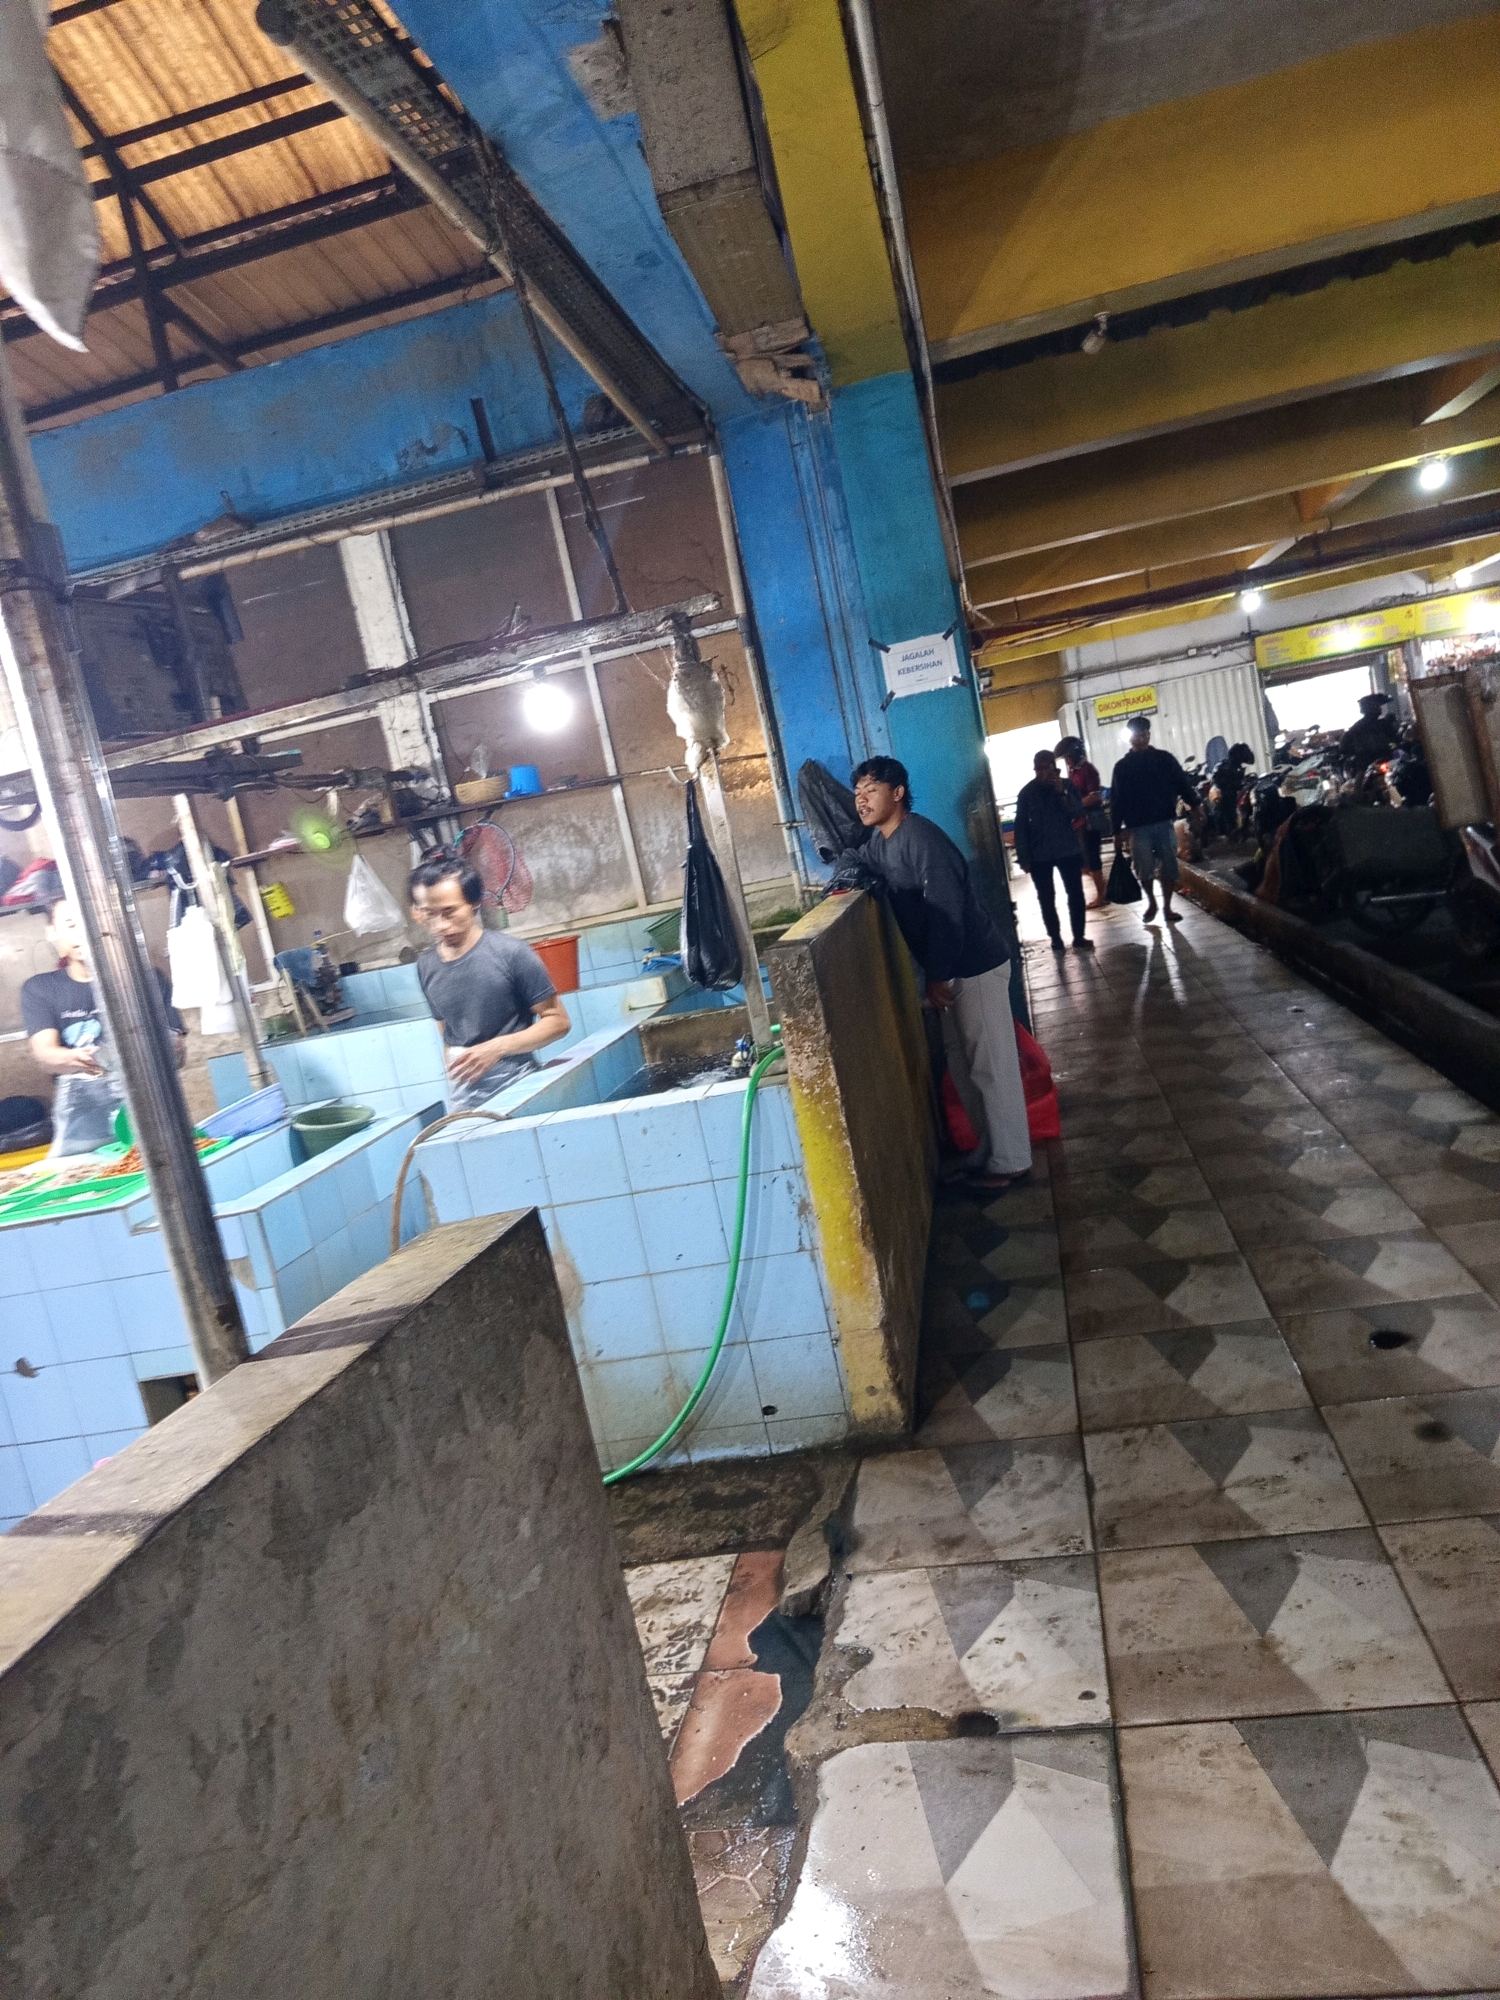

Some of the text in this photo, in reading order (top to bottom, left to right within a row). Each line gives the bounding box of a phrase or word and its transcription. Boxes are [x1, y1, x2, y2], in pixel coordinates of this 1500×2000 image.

[901, 647, 935, 662] JAGALAH
[897, 659, 943, 676] KEBERSIHAN
[1098, 693, 1153, 713] DIKONTRAKAN
